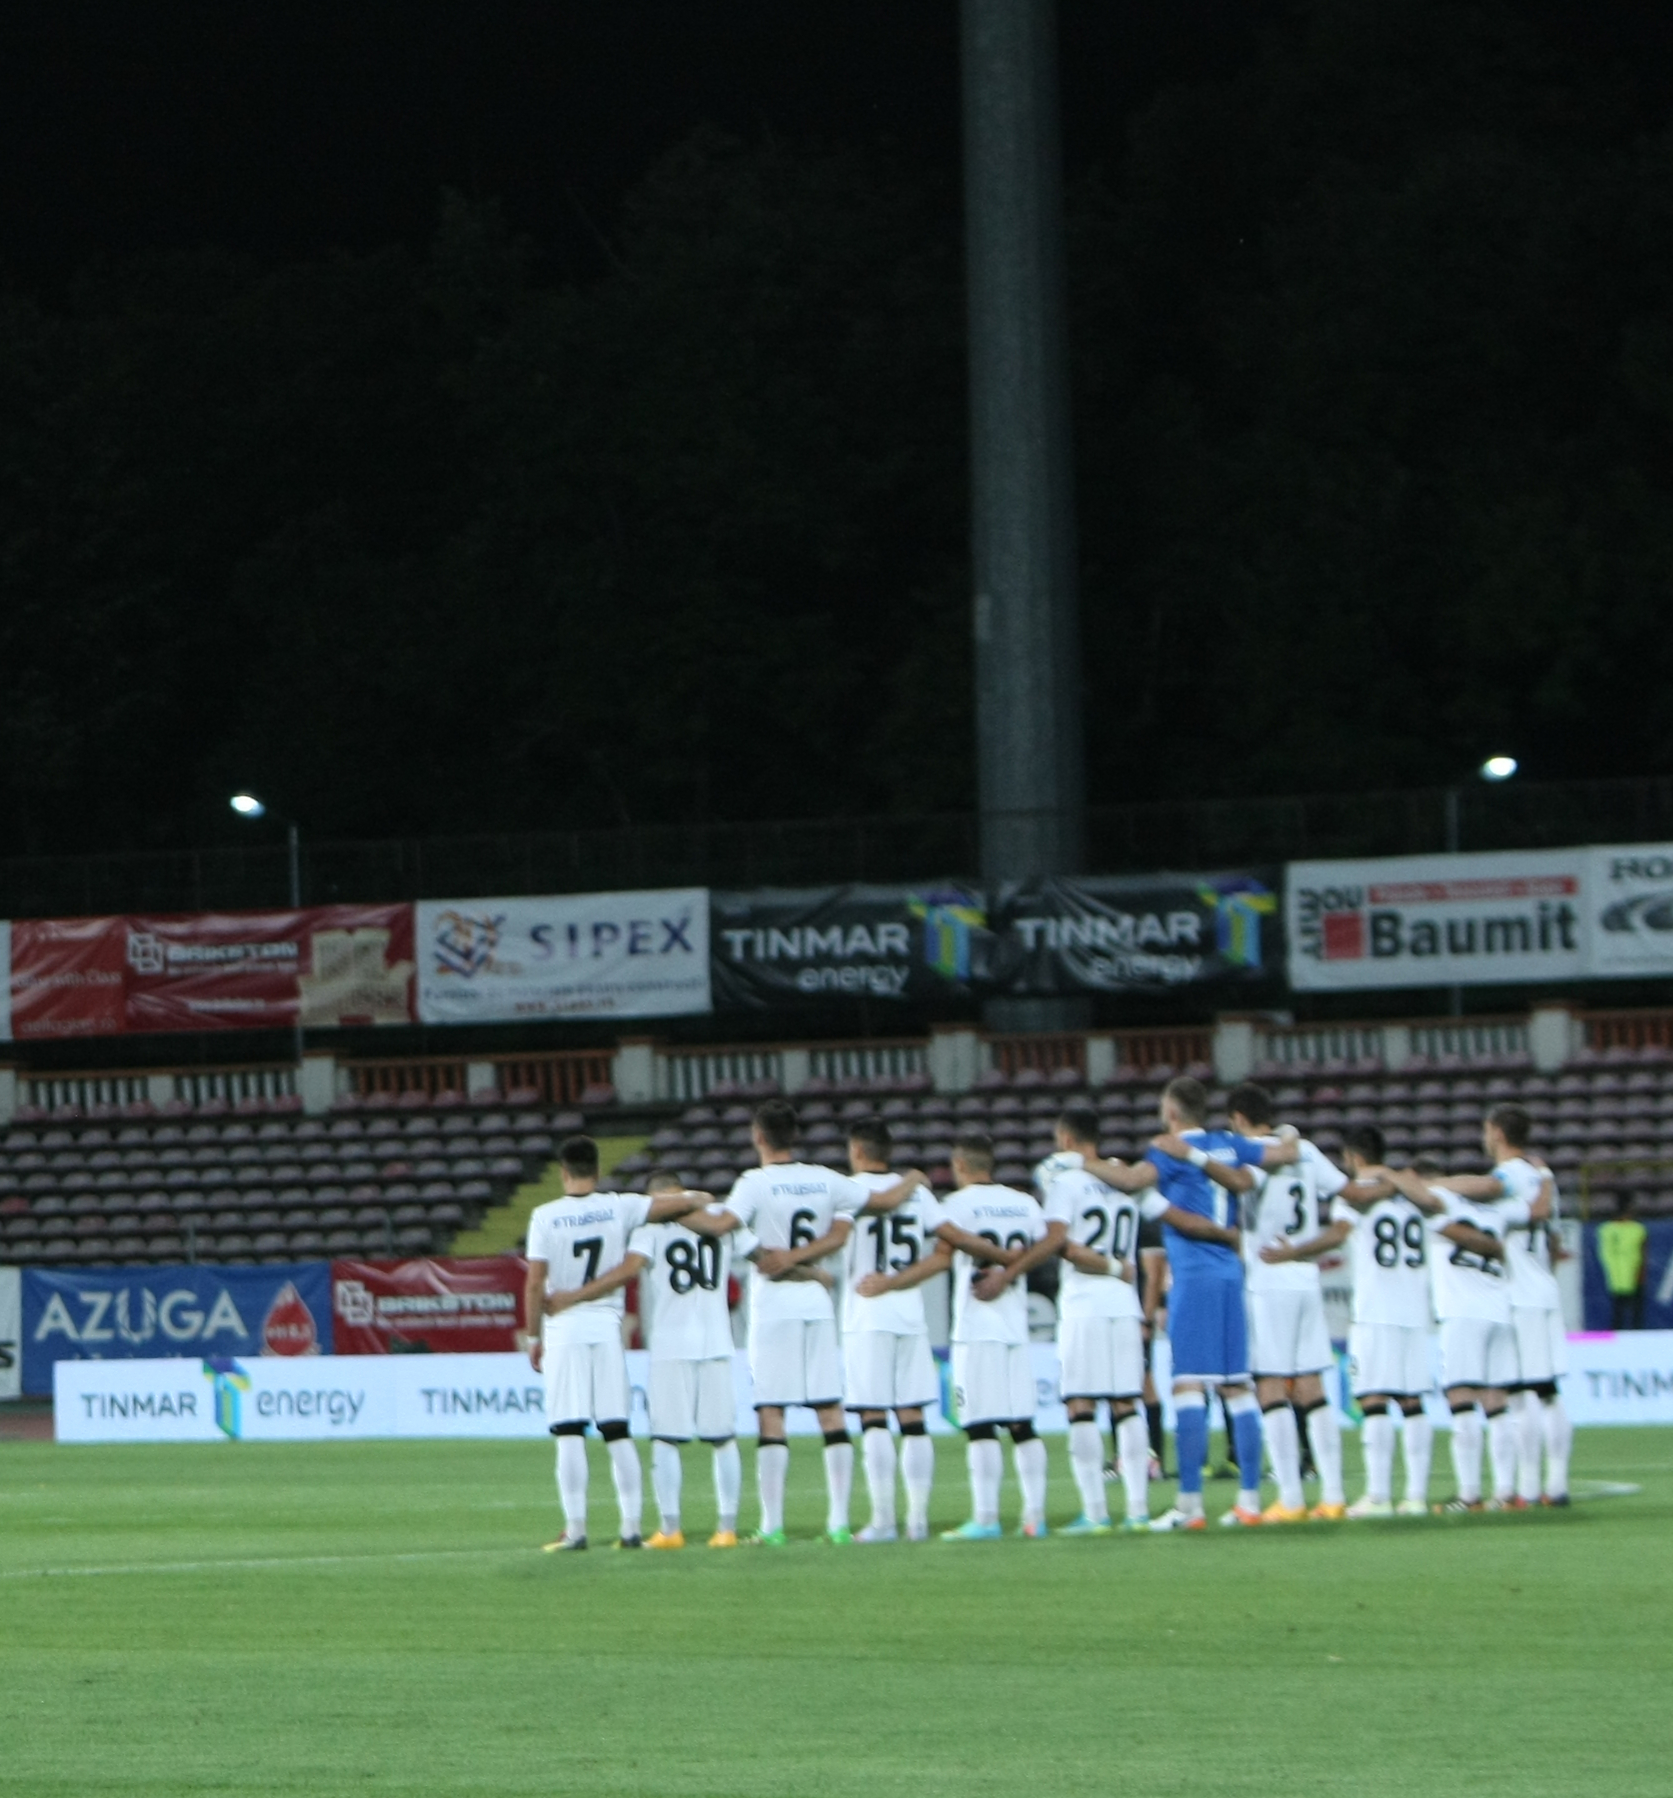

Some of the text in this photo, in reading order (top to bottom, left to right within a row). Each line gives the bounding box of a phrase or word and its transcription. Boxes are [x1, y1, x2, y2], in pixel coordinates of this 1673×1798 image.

[530, 914, 693, 960] SIPEX
[721, 923, 910, 962] TINMAR
[1014, 911, 1202, 952] TINMAR
[1370, 901, 1577, 958] Baumit
[795, 964, 910, 997] energy
[1083, 1206, 1134, 1259] 20
[1285, 1183, 1305, 1236] 3
[573, 1236, 605, 1288] 7
[666, 1237, 722, 1295] 80
[867, 1214, 920, 1272] 15
[1374, 1216, 1425, 1268] 89
[34, 1287, 250, 1346] AZUGA
[82, 1392, 198, 1420] TINMAR
[258, 1388, 366, 1426] energy
